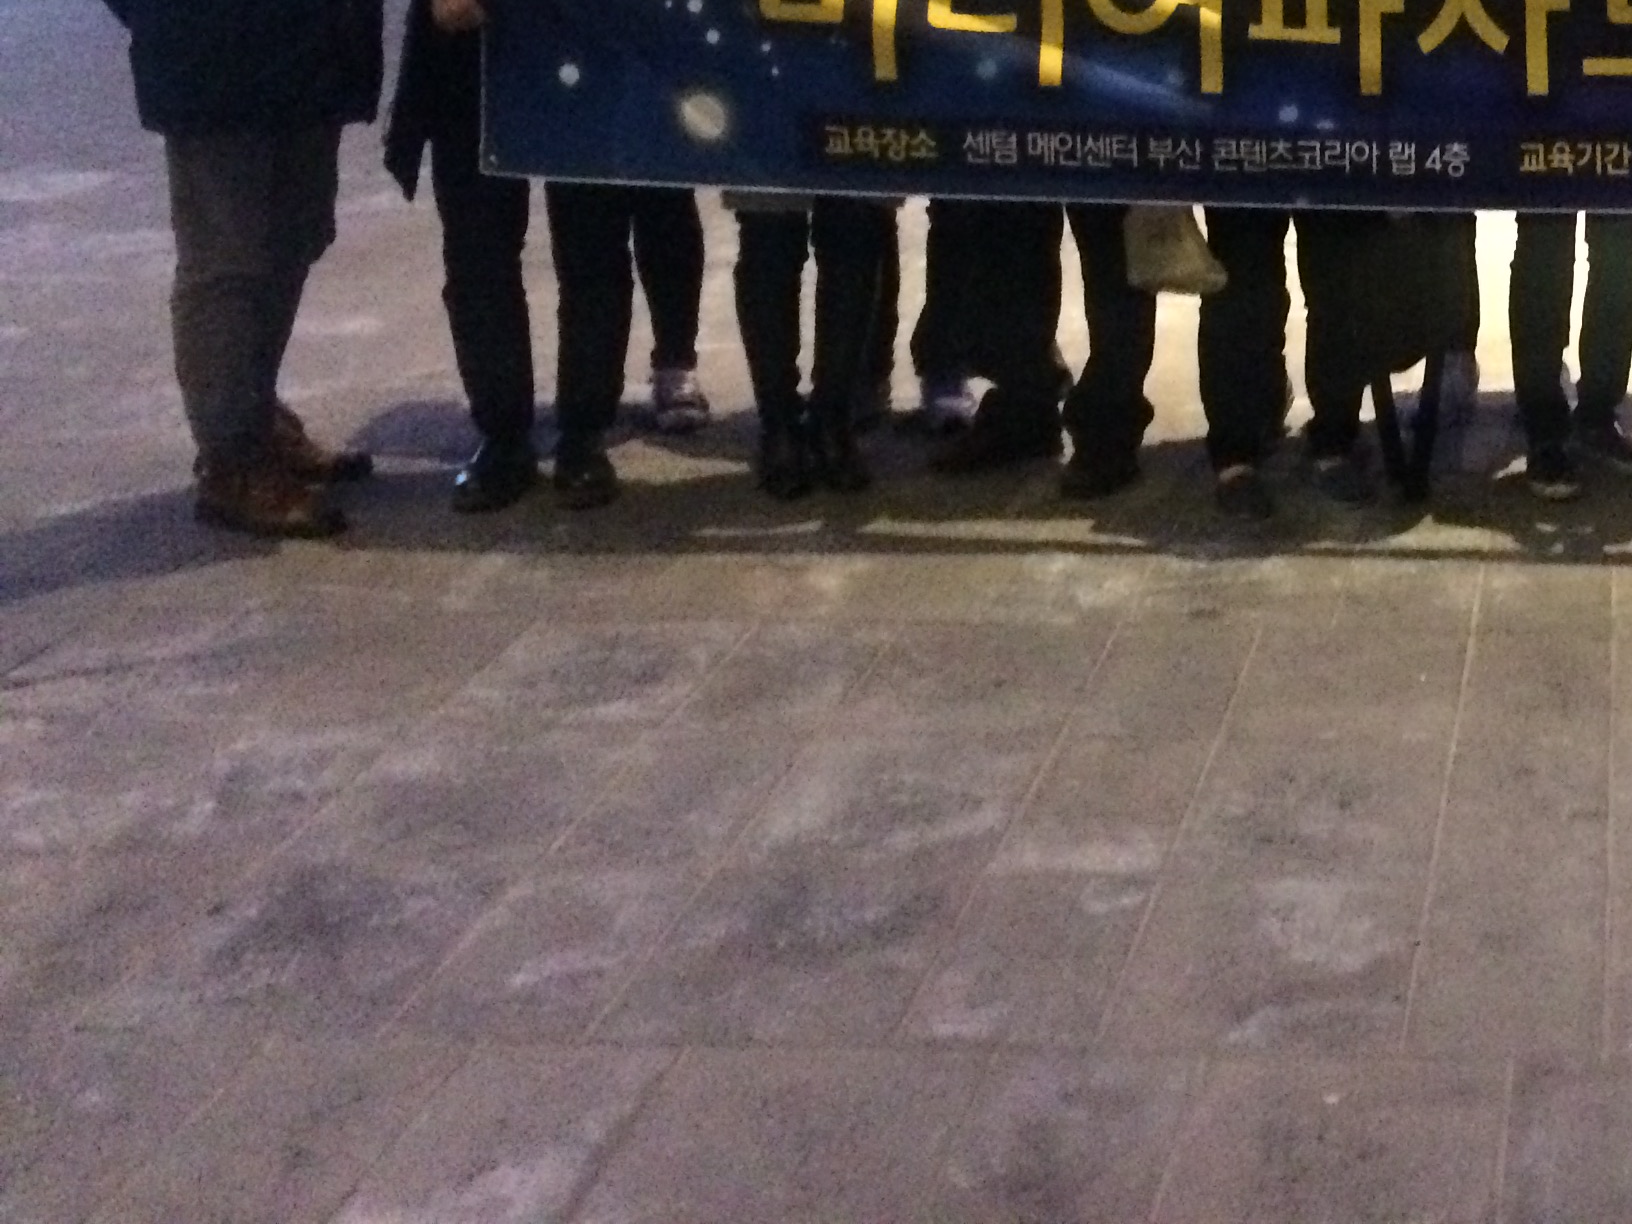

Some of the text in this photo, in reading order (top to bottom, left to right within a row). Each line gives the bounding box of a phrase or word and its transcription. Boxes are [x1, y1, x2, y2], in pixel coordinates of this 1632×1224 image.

[824, 126, 938, 162] 교육장소
[962, 130, 1018, 164] 센텀
[1027, 131, 1138, 167] 메인센터
[1148, 136, 1201, 171] 부산
[1389, 140, 1416, 176] 랩
[1425, 142, 1471, 178] 4층
[1519, 141, 1632, 176] 교육기간
